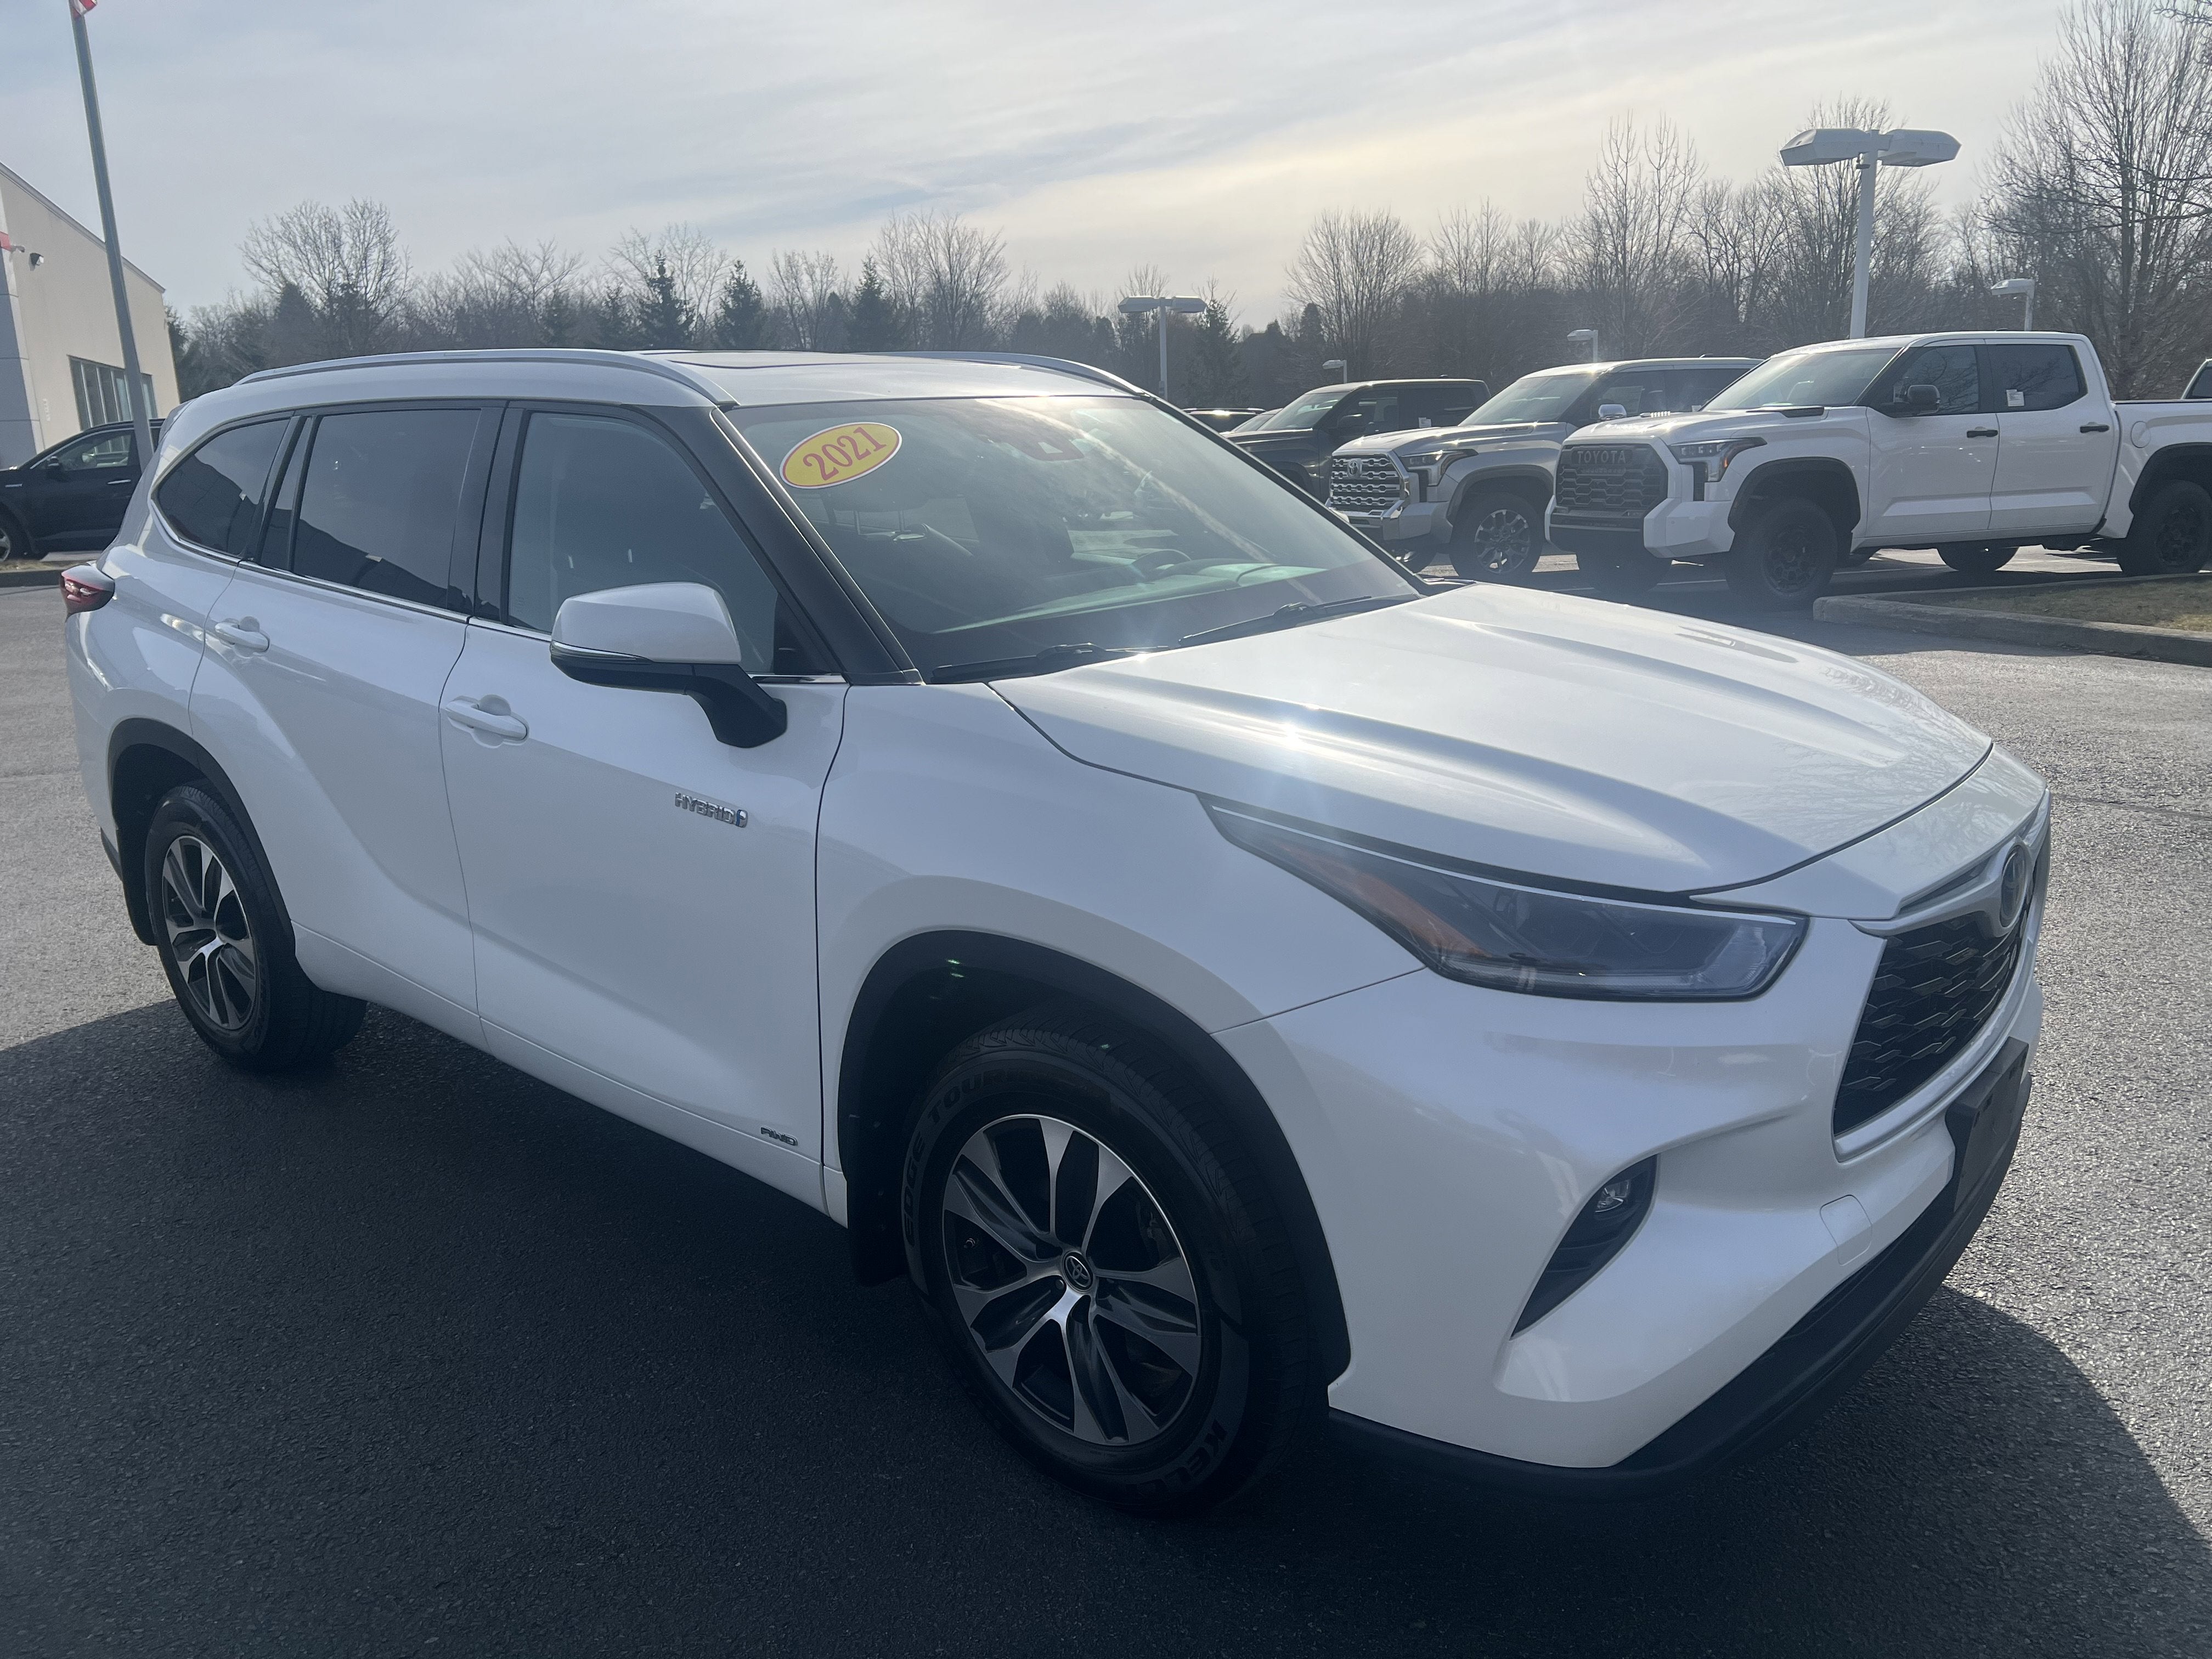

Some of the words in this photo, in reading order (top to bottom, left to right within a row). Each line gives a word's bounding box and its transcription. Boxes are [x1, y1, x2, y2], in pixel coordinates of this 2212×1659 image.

[803, 427, 887, 481] 2021
[1577, 450, 1626, 464] TOYOTA
[675, 792, 736, 824] HYBRID
[760, 1126, 798, 1146] AWD
[904, 1131, 926, 1247] EDGE
